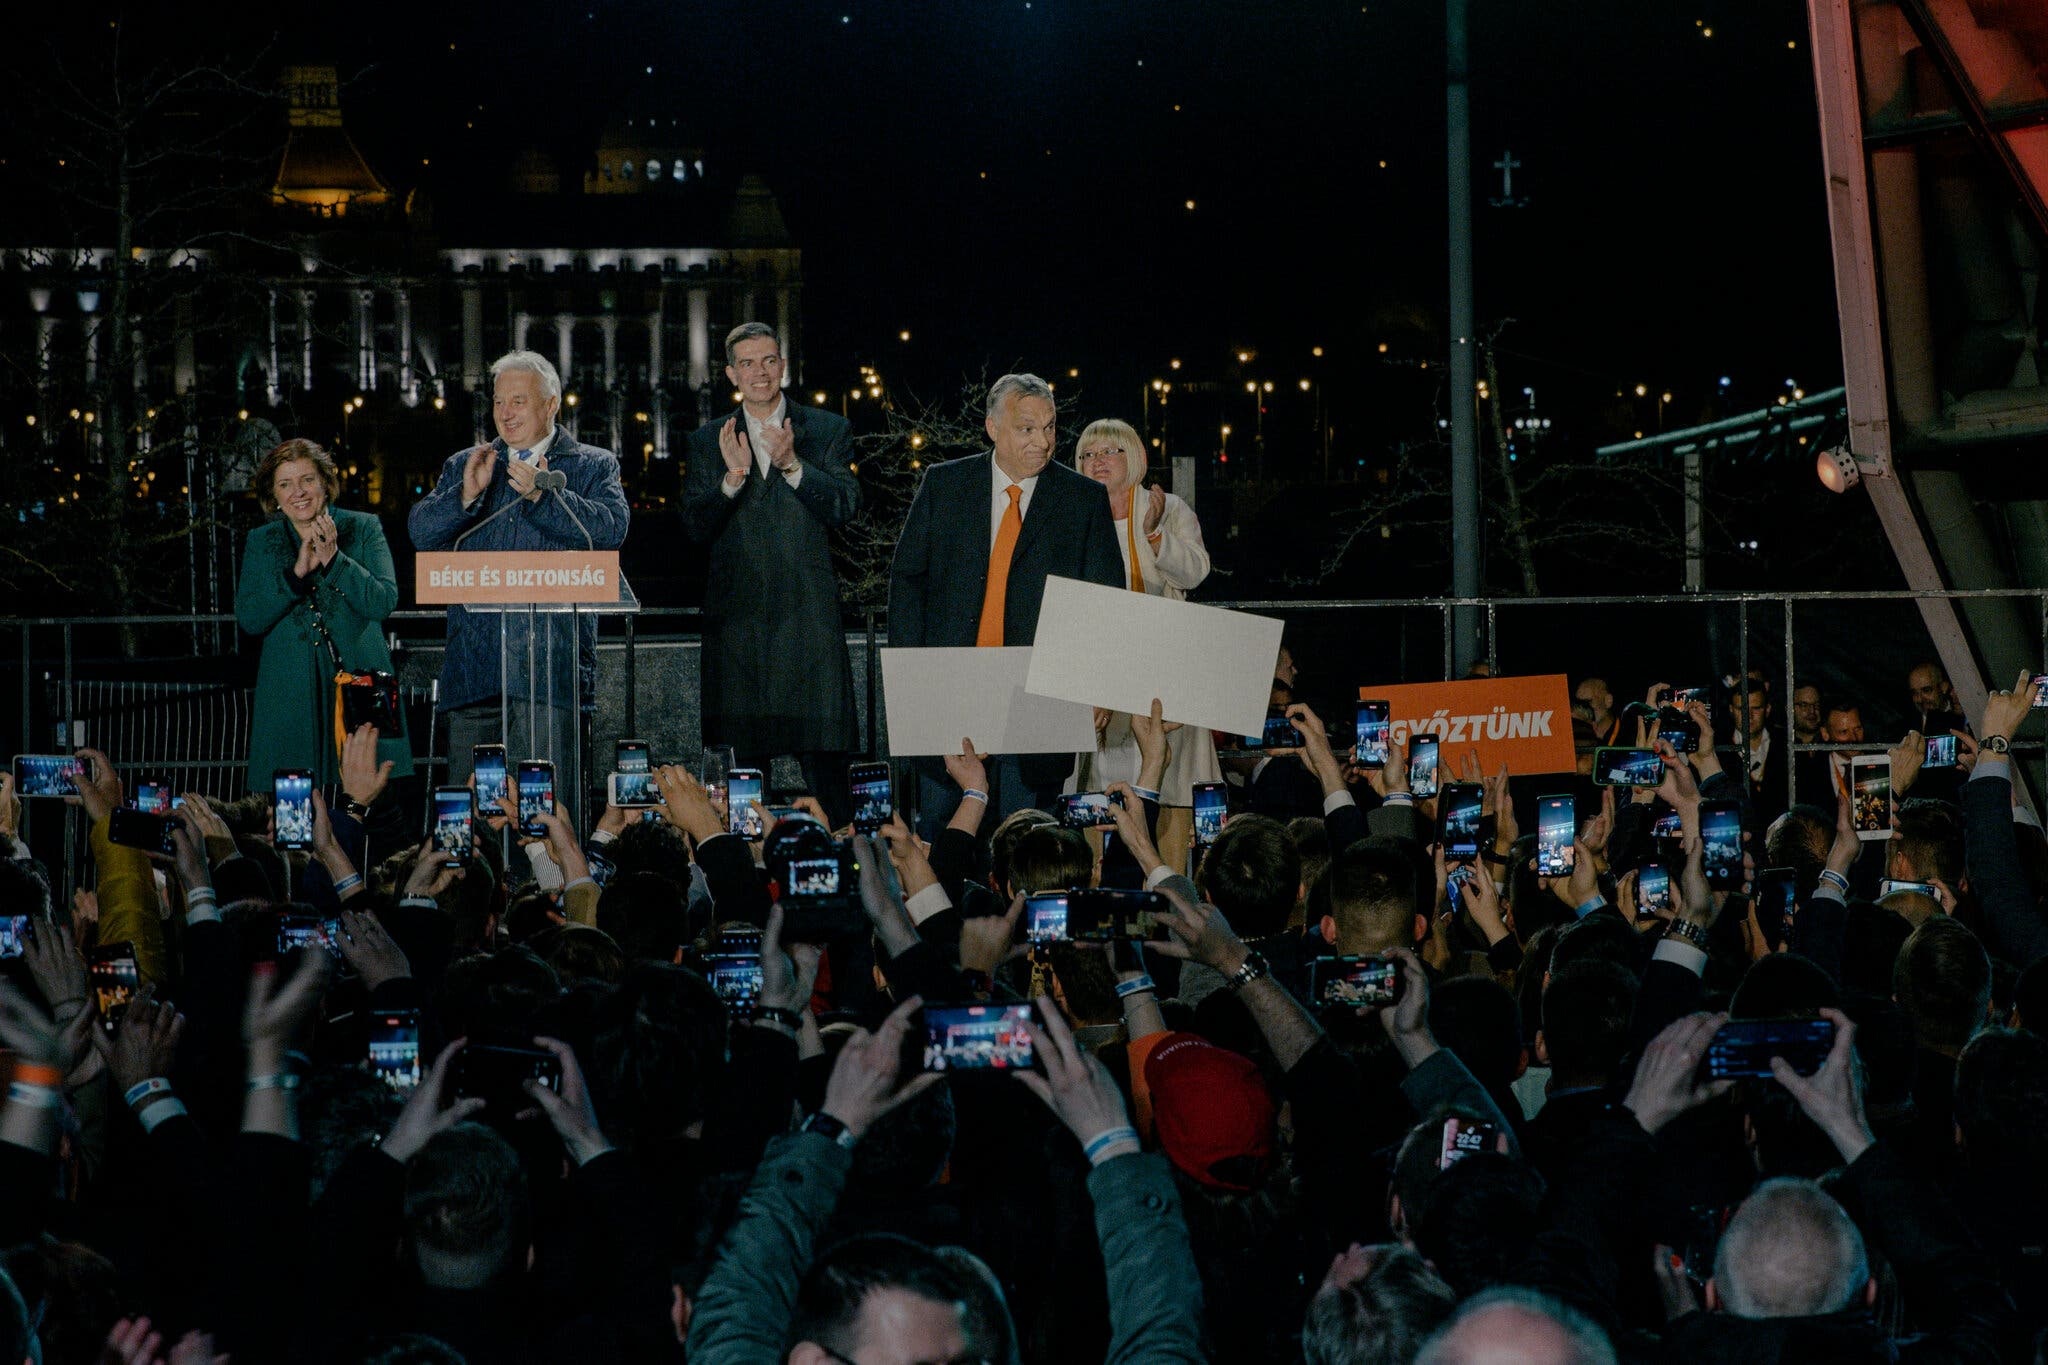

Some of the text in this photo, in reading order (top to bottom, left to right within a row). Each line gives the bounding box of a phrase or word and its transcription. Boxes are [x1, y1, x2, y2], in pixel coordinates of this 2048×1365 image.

[429, 564, 605, 587] BÉKE ÉS BIZTONSÁG
[1390, 706, 1554, 746] GYŐZTÜNK
